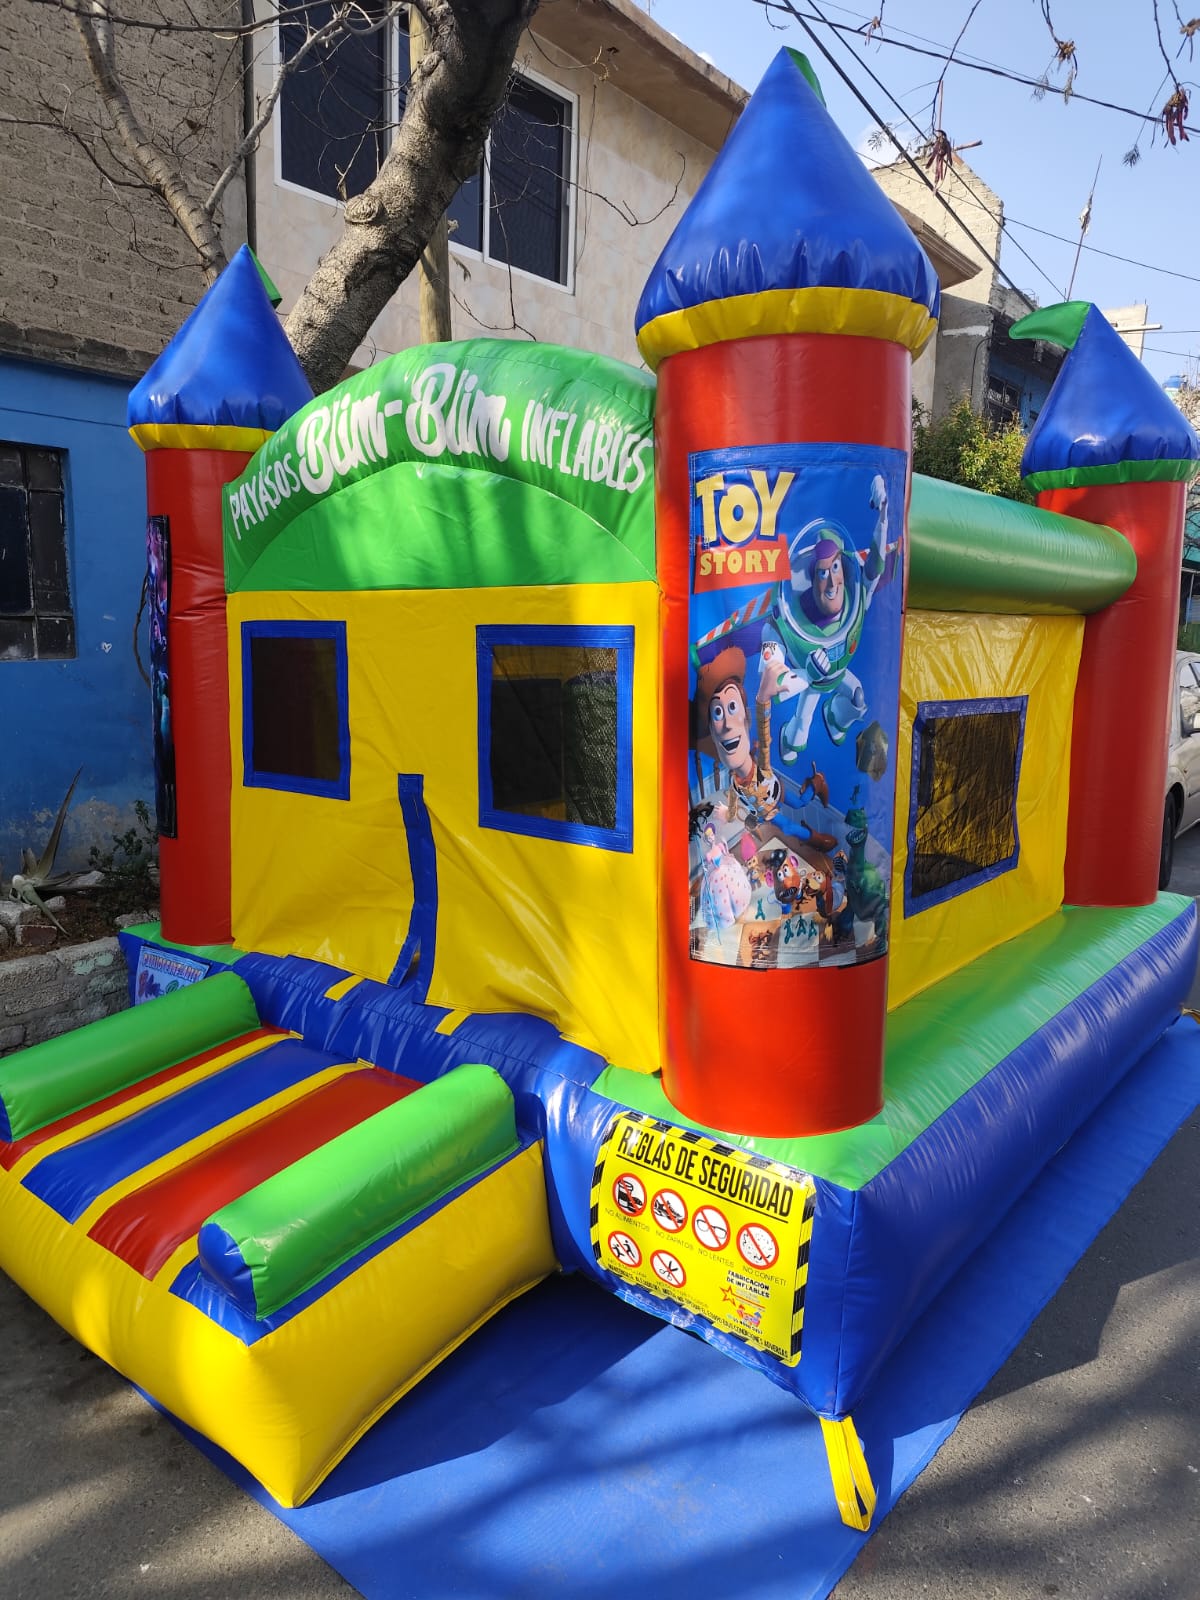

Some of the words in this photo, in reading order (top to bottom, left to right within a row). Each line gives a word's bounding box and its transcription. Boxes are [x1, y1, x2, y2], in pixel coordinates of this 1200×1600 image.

[229, 452, 300, 540] PAYASOS
[521, 399, 652, 493] INFLABLES
[695, 469, 796, 544] TOY
[699, 549, 782, 576] STORY
[617, 1126, 675, 1171] REGLAS
[675, 1147, 696, 1180] DE
[698, 1155, 794, 1218] SEGURIDAD
[615, 1212, 650, 1232] ALIMENTOS
[698, 1248, 708, 1257] NO
[709, 1252, 735, 1267] LENTES
[742, 1265, 754, 1275] NO
[754, 1270, 787, 1287] CONFETI
[735, 1280, 770, 1298] INFLABLES
